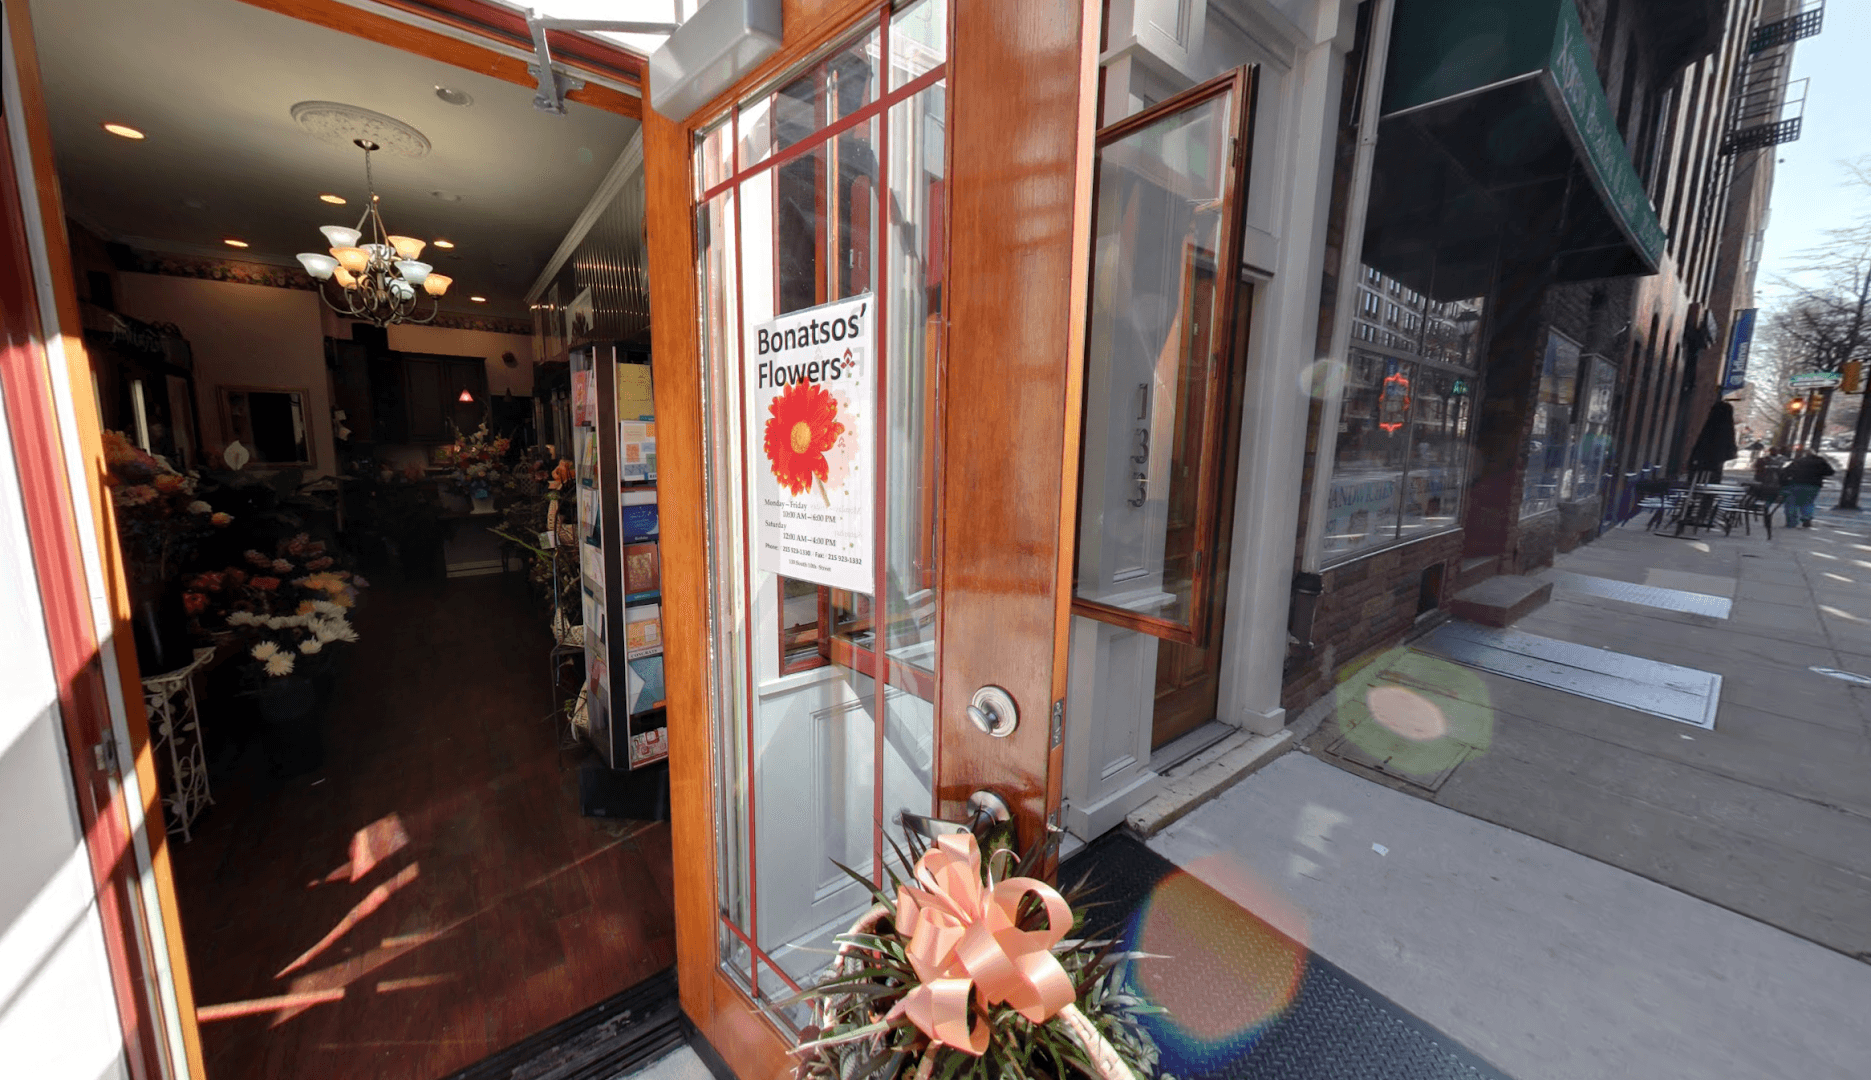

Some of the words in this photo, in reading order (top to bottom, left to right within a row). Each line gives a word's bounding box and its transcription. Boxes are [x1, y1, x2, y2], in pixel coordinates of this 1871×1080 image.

[758, 357, 841, 389] Flowers
[764, 499, 784, 510] Monday
[790, 500, 807, 511] Friday
[796, 512, 807, 520] AM
[812, 513, 825, 522] 6:00
[825, 515, 836, 523] PM
[765, 520, 787, 531] Saturday
[796, 534, 807, 542] AM
[824, 538, 836, 547] PM
[838, 555, 862, 565] 923-1332
